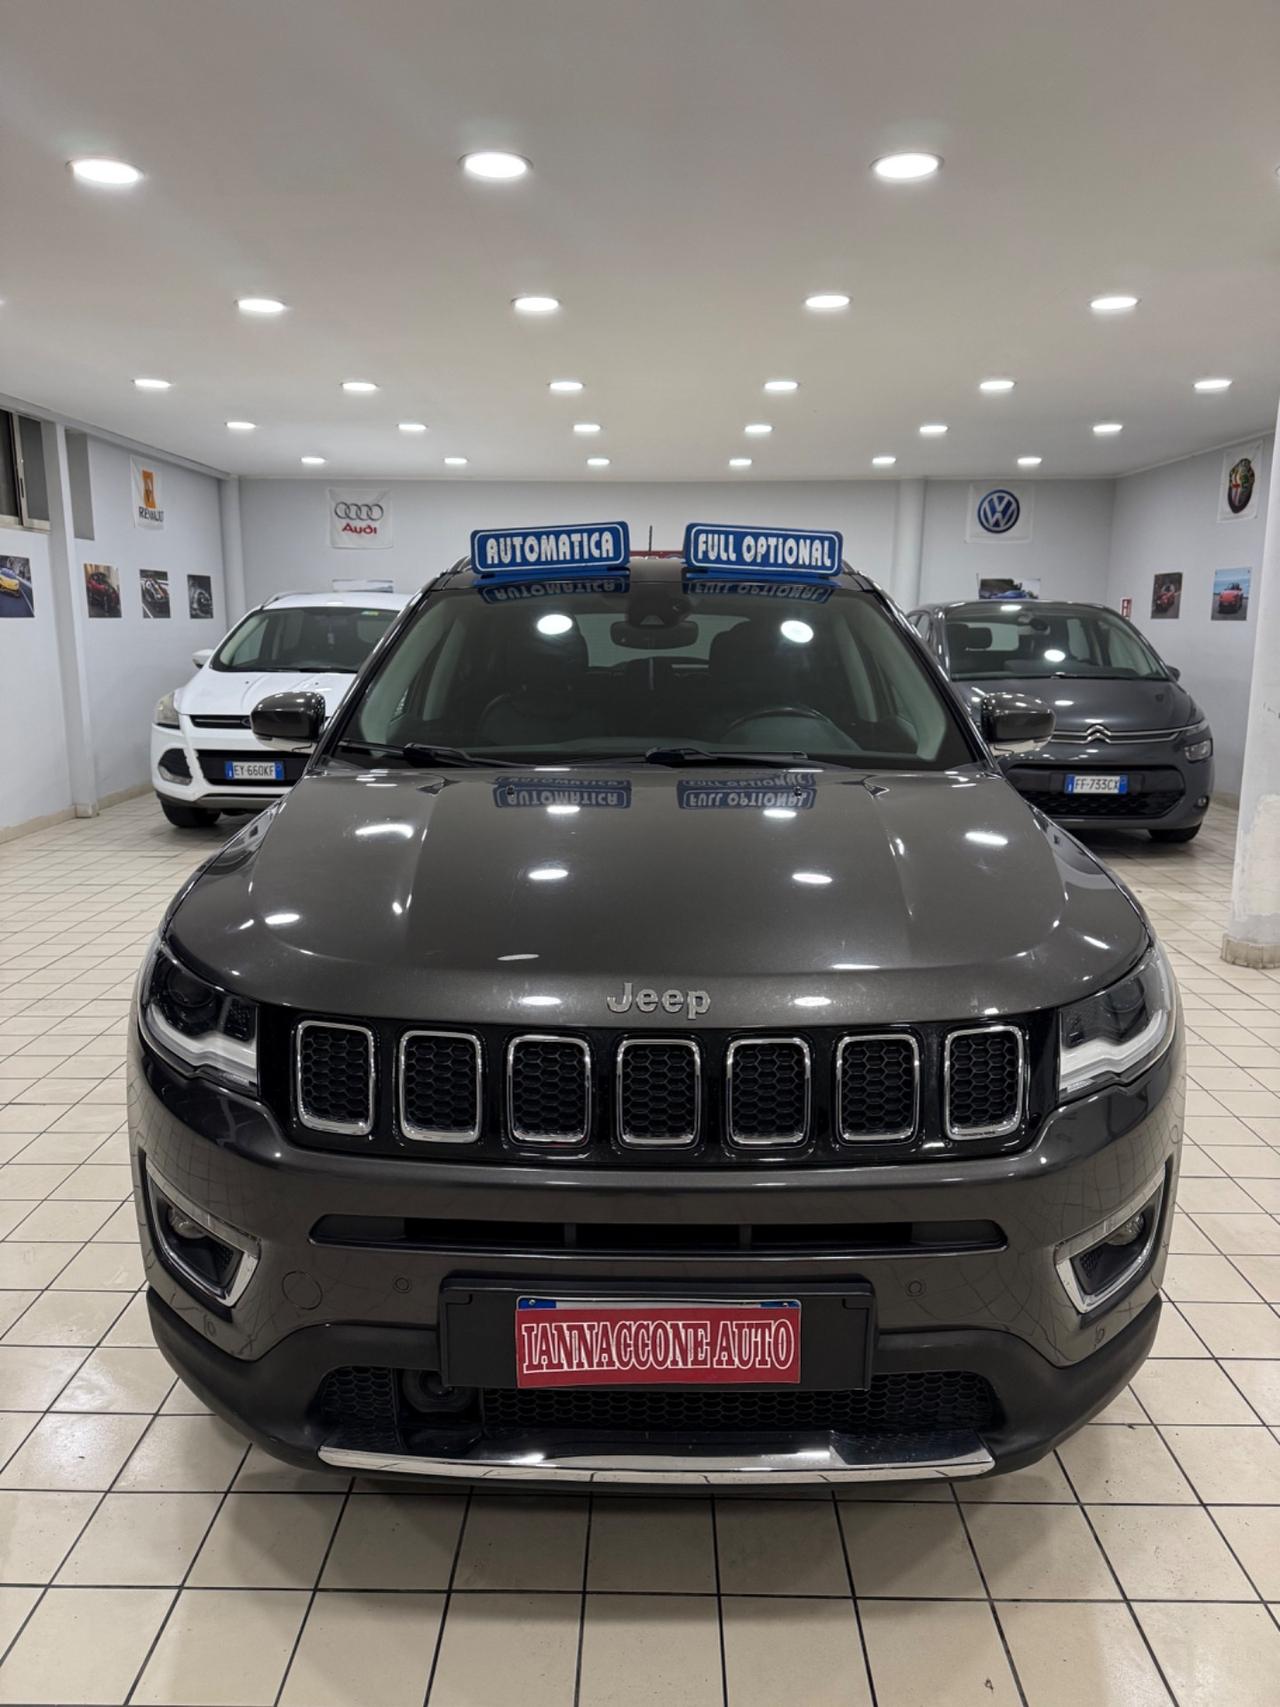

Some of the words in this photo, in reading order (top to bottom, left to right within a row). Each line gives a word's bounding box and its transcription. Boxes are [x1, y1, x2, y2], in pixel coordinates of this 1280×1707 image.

[342, 522, 377, 534] Audi
[486, 530, 614, 564] AUTOMATICA
[697, 533, 736, 561] FULL
[742, 535, 832, 567] OPTIONAL
[606, 982, 712, 1020] Jeep
[522, 1320, 710, 1373] IANNACCONE
[713, 1319, 794, 1369] AUTO
